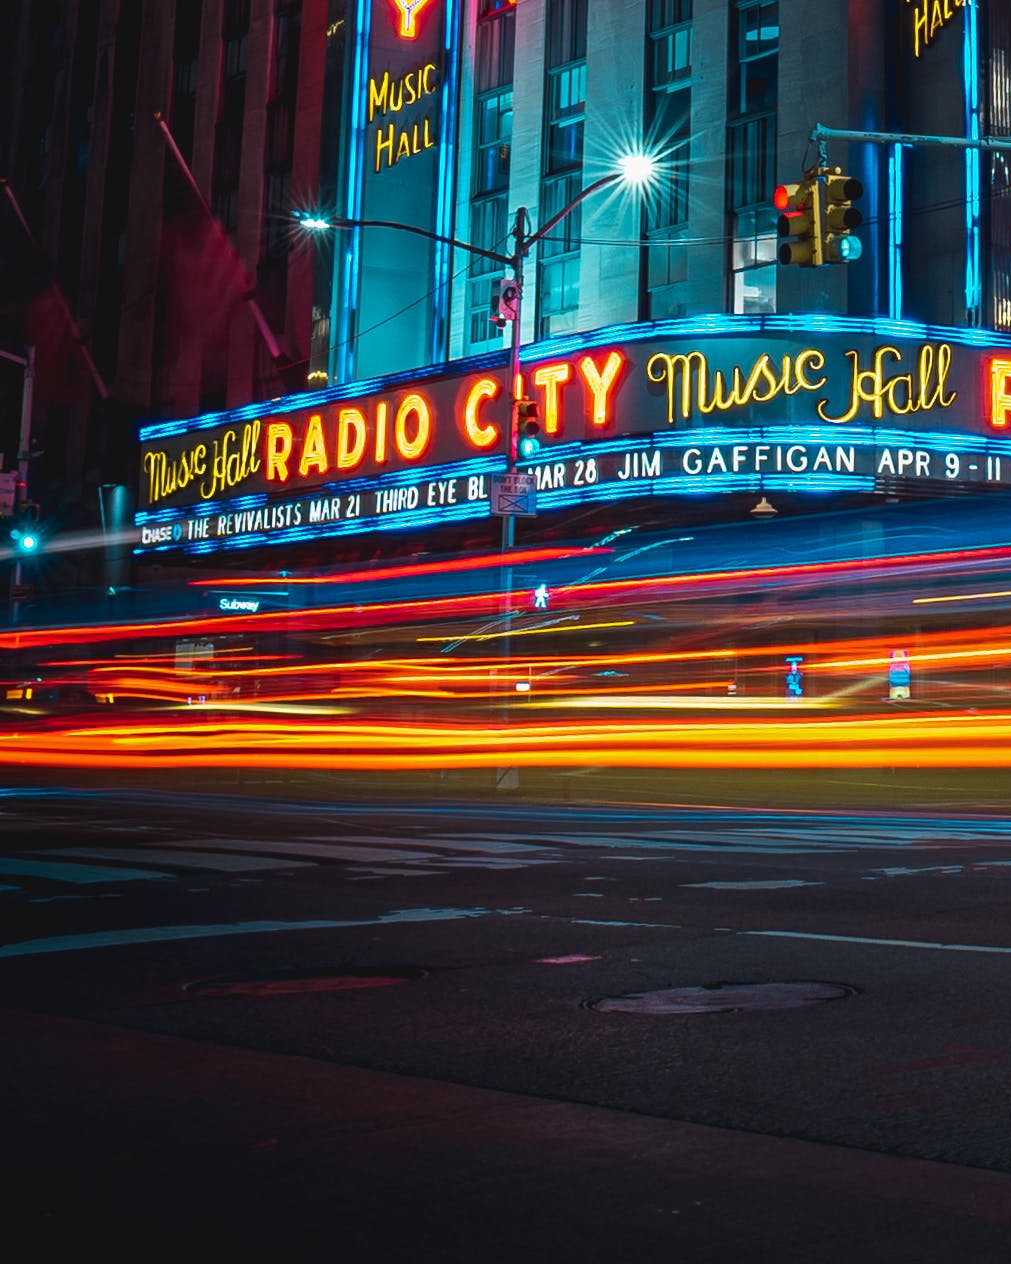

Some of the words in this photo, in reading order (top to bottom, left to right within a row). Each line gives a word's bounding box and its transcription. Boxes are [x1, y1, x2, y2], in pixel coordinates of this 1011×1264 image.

[374, 118, 434, 173] HALL
[647, 348, 828, 425] Music
[817, 343, 958, 424] Hall
[145, 442, 207, 503] Music
[202, 420, 262, 499] Hall
[267, 393, 432, 483] RADIO
[187, 519, 210, 541] THE
[217, 503, 302, 536] REVIVALISTS
[309, 498, 341, 523] MAR
[346, 494, 361, 518] 21
[374, 488, 420, 515] THIRD
[427, 479, 457, 507] EYE
[573, 458, 598, 486] 28
[617, 450, 662, 480] JIM
[682, 444, 856, 476] GAFFIGAN
[877, 448, 931, 478] APR
[219, 598, 260, 613] Subway
